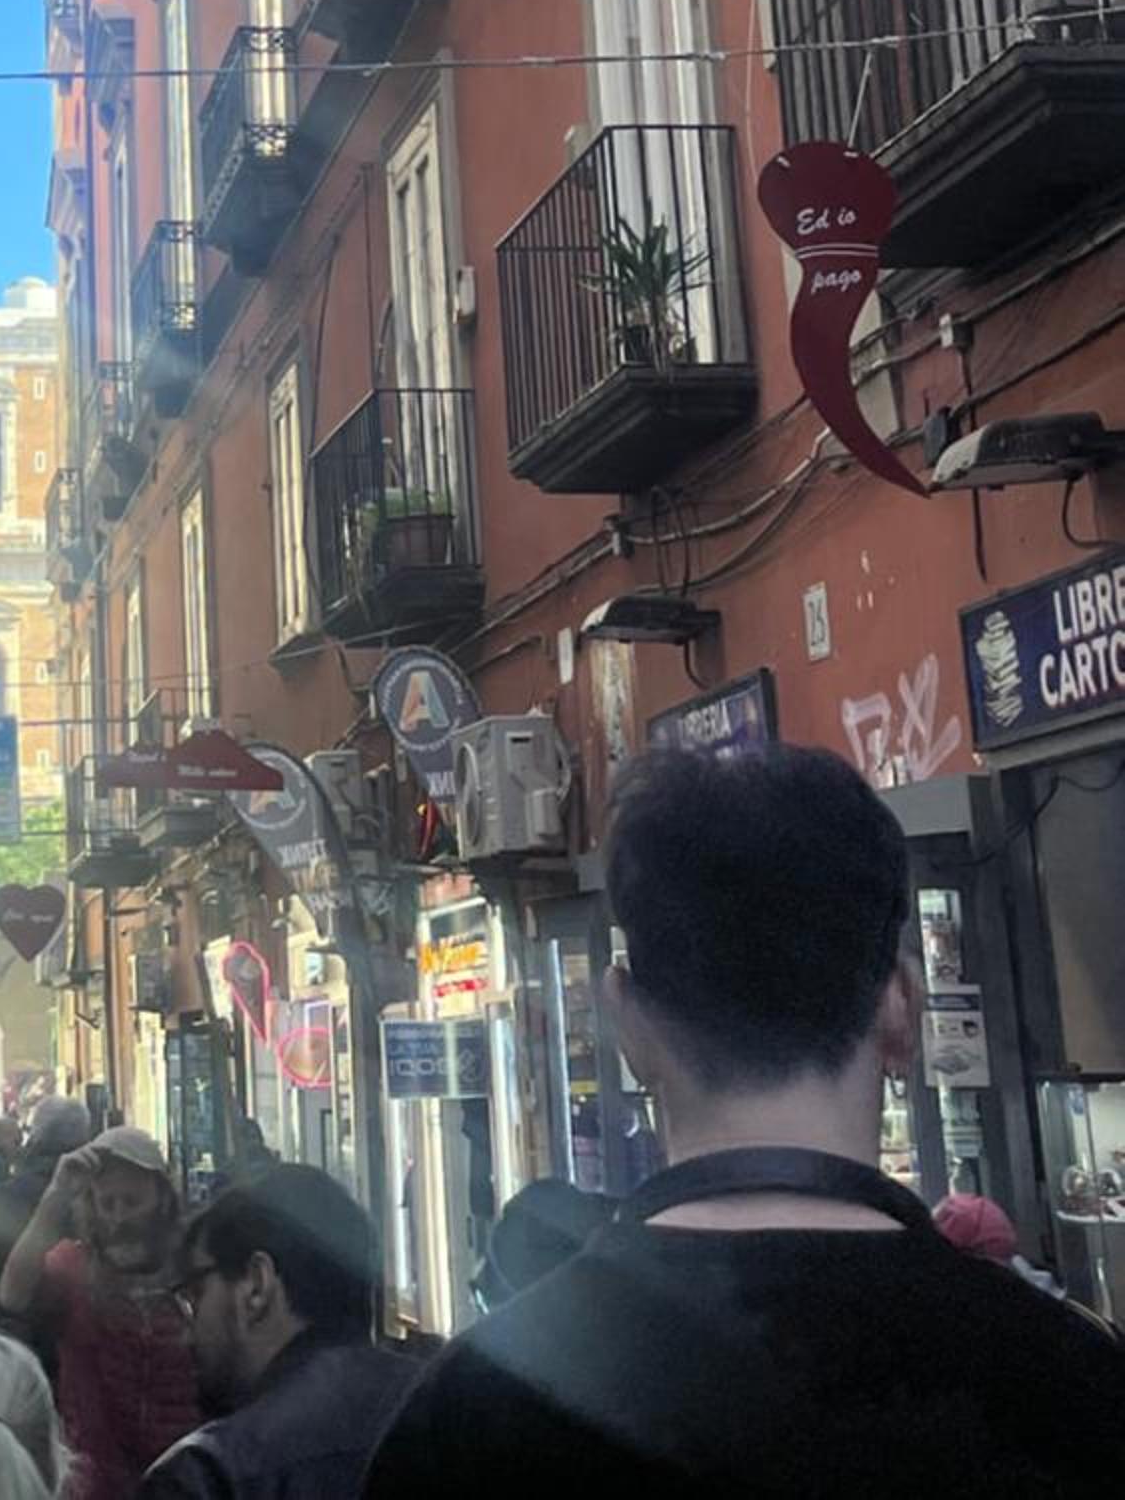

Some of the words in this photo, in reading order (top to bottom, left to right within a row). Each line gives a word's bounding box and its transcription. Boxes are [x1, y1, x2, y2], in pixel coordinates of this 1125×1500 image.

[796, 207, 830, 235] Ed
[810, 269, 862, 294] pago
[1053, 565, 1125, 643] LIBRE
